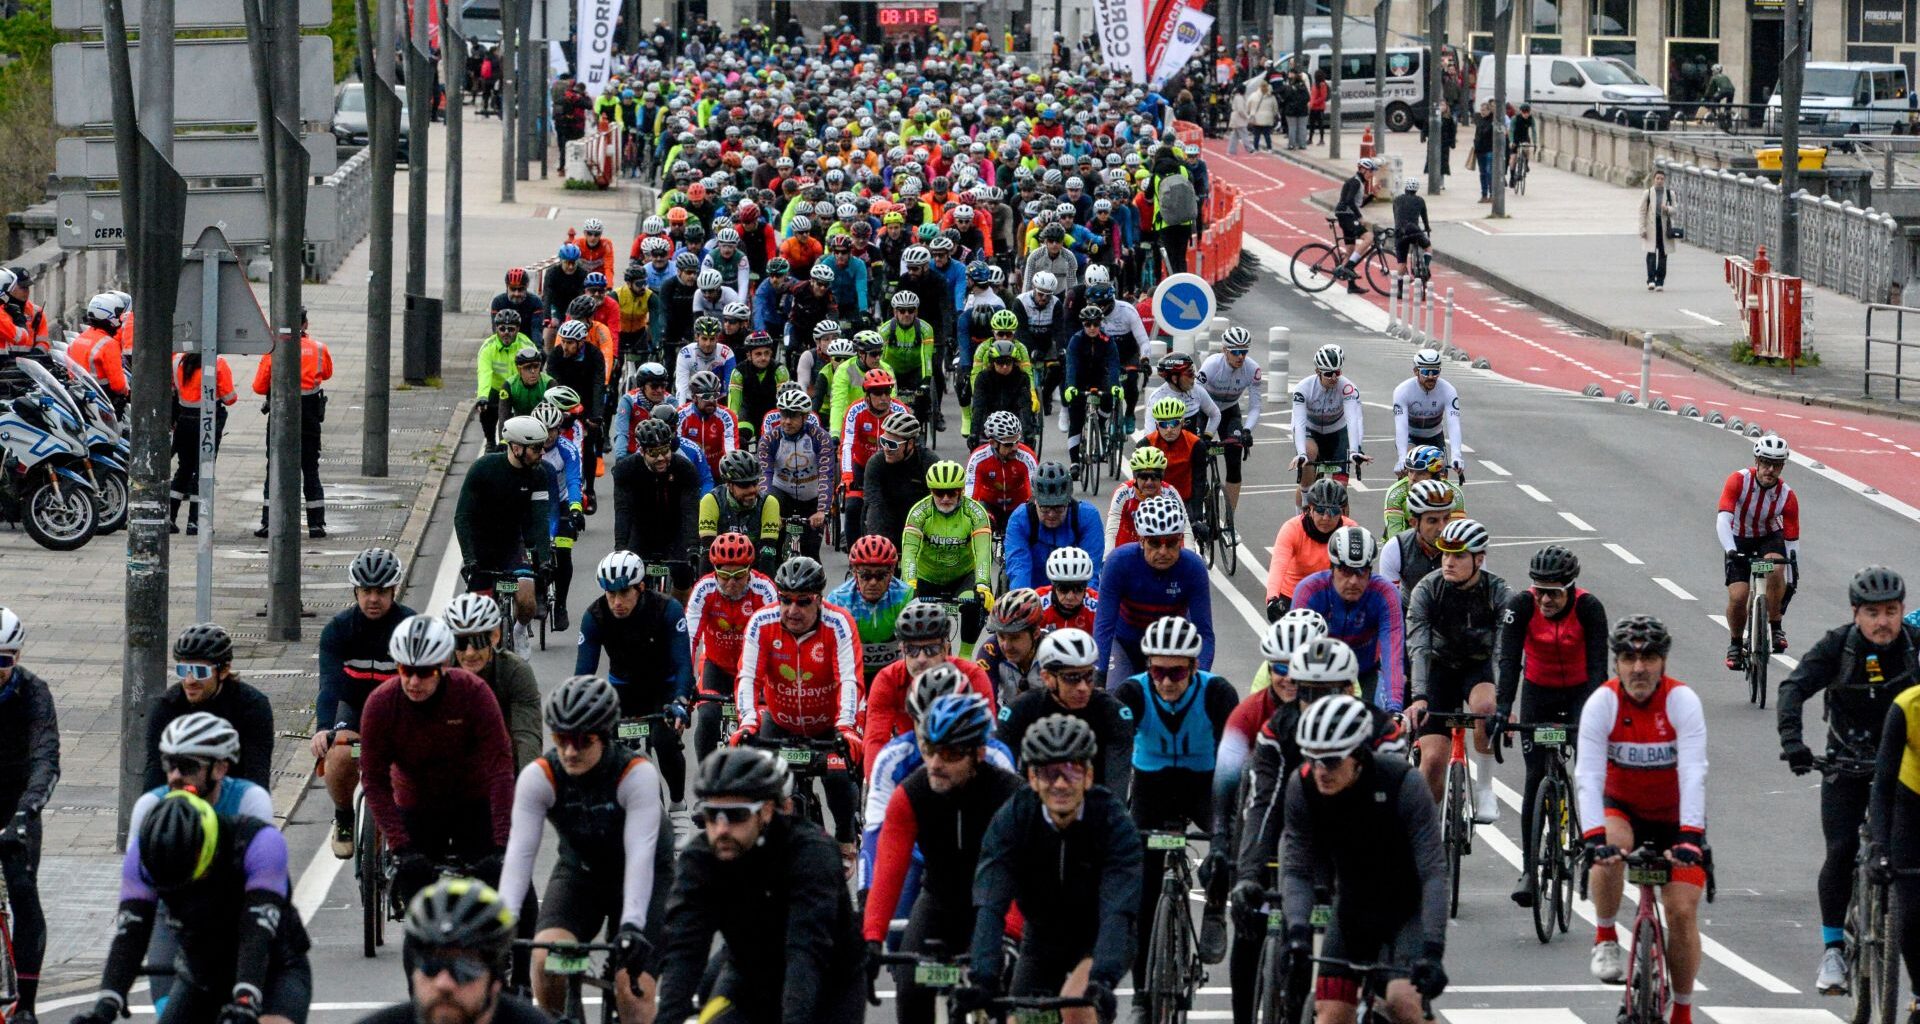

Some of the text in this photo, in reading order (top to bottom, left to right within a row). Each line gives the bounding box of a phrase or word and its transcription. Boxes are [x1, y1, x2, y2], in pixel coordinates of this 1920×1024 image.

[1865, 11, 1903, 20] FITNESS PARK
[589, 58, 605, 83] EL
[94, 228, 126, 239] CEPR
[930, 535, 958, 545] Nuez
[627, 726, 649, 736] 3215
[1543, 730, 1565, 740] 4976
